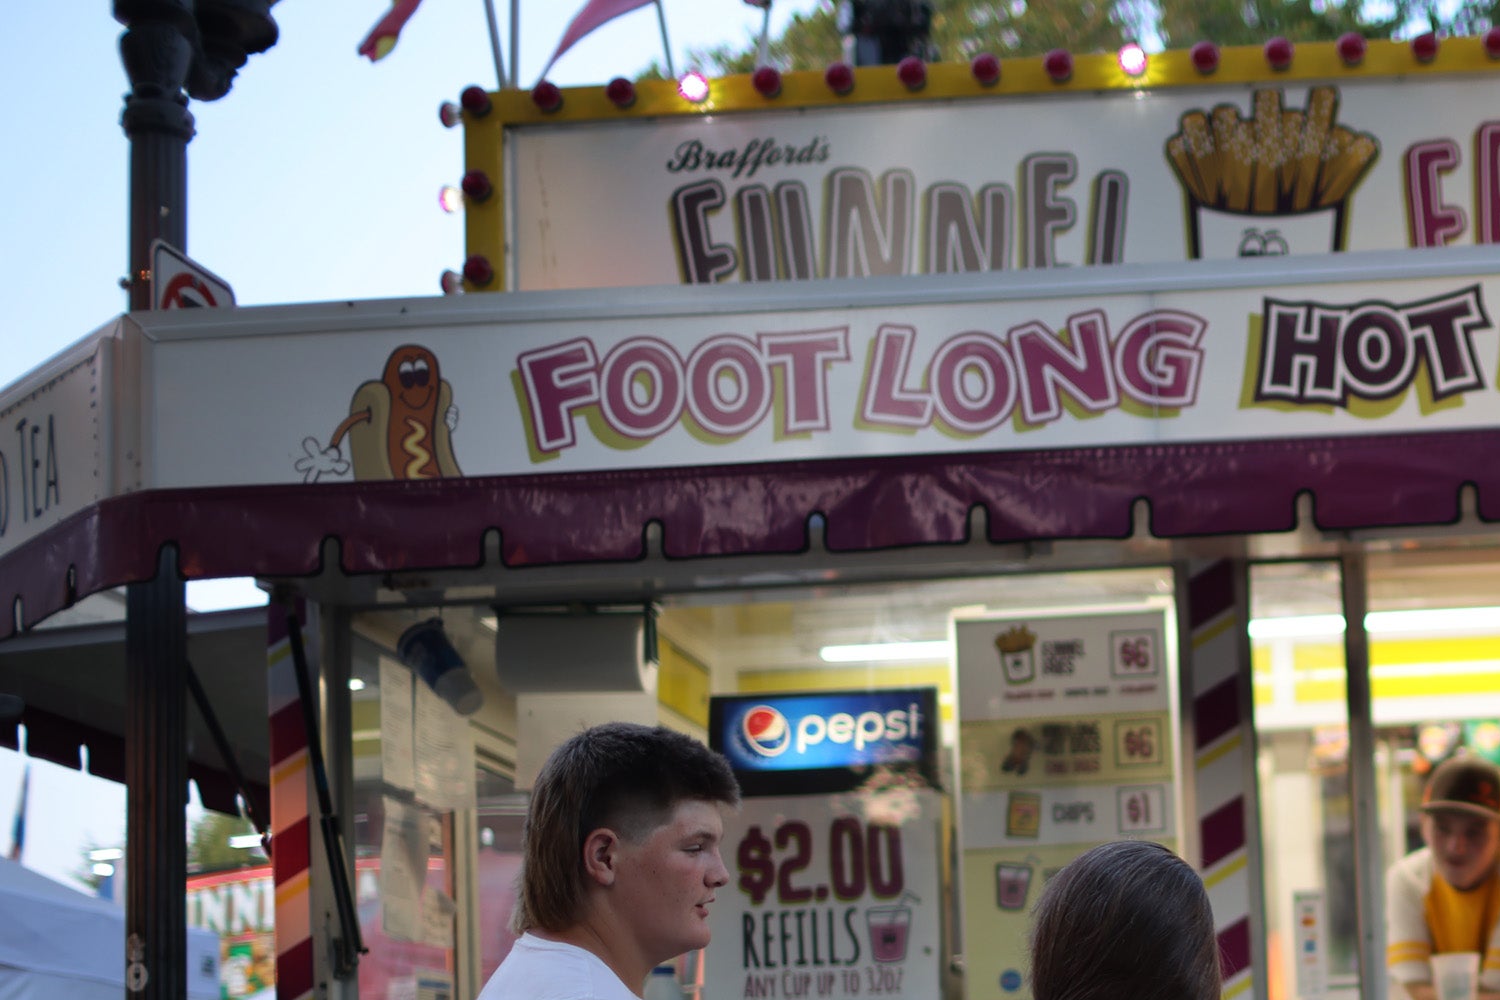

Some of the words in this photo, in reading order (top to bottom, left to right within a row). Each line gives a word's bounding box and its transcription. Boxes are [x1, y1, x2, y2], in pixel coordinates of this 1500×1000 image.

[667, 136, 832, 176] Brafford's
[514, 325, 850, 458] FOOT
[857, 310, 1209, 434] LONG
[1248, 283, 1494, 412] HOT
[16, 414, 59, 523] TEA
[797, 703, 920, 752] pepsi
[737, 813, 904, 905] $2.00
[742, 906, 860, 969] REFILLS
